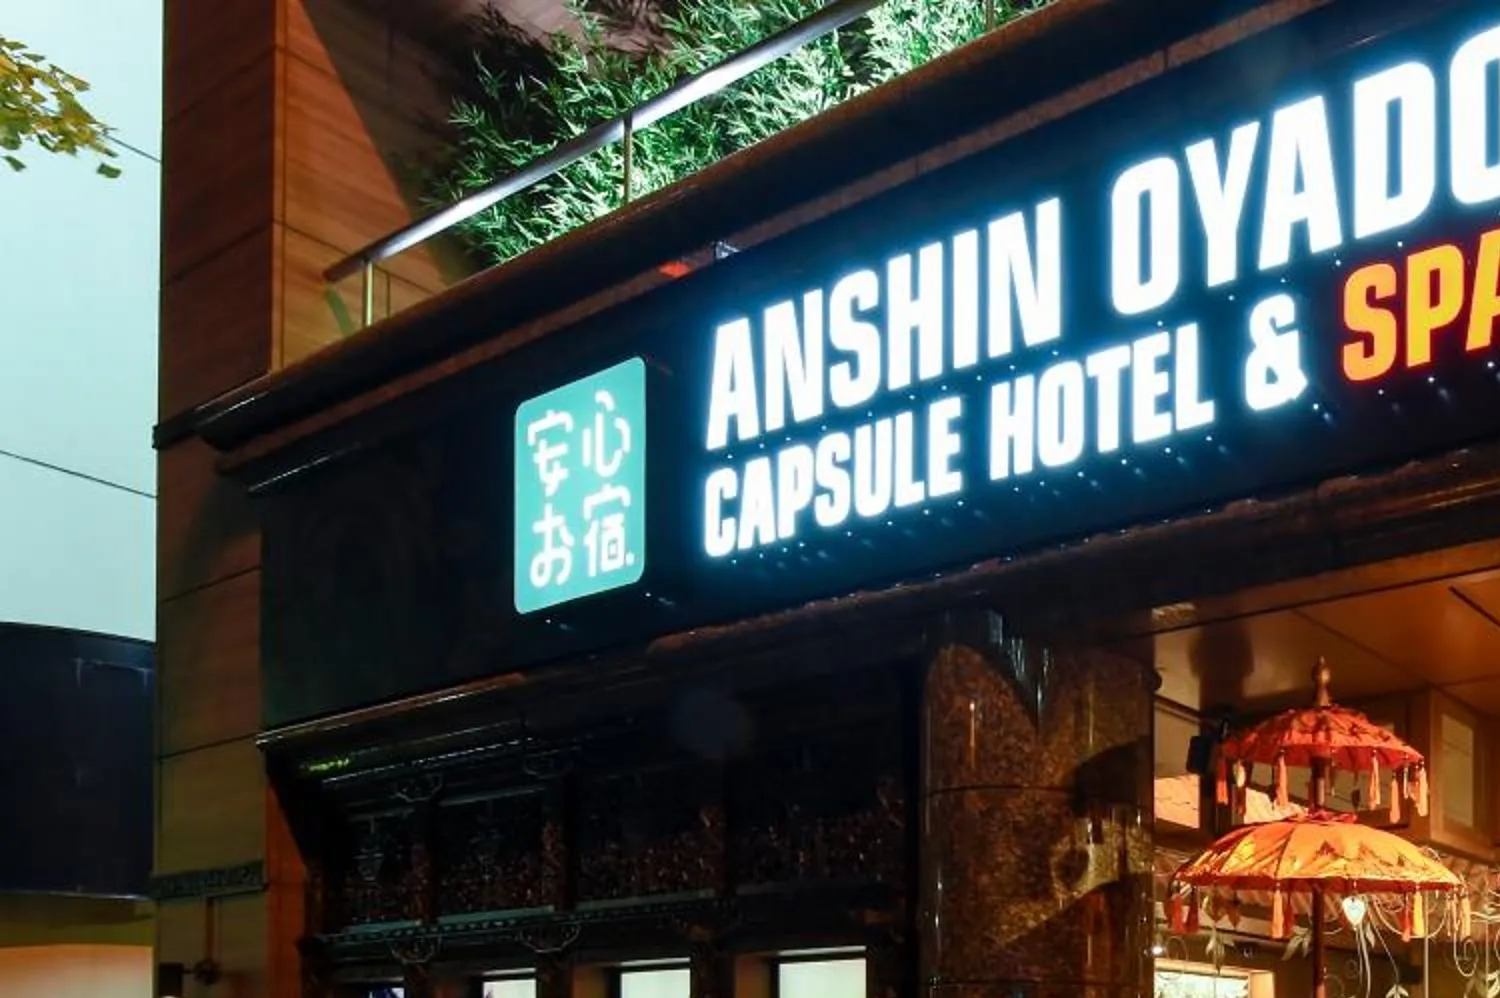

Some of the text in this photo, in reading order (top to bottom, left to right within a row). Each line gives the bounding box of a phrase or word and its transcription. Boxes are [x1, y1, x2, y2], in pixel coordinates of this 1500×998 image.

[527, 389, 631, 497] 安心
[704, 397, 963, 558] CAPSULE
[989, 323, 1214, 481] HOTEL
[1243, 294, 1308, 413] &
[705, 198, 1061, 451] ANSHIN
